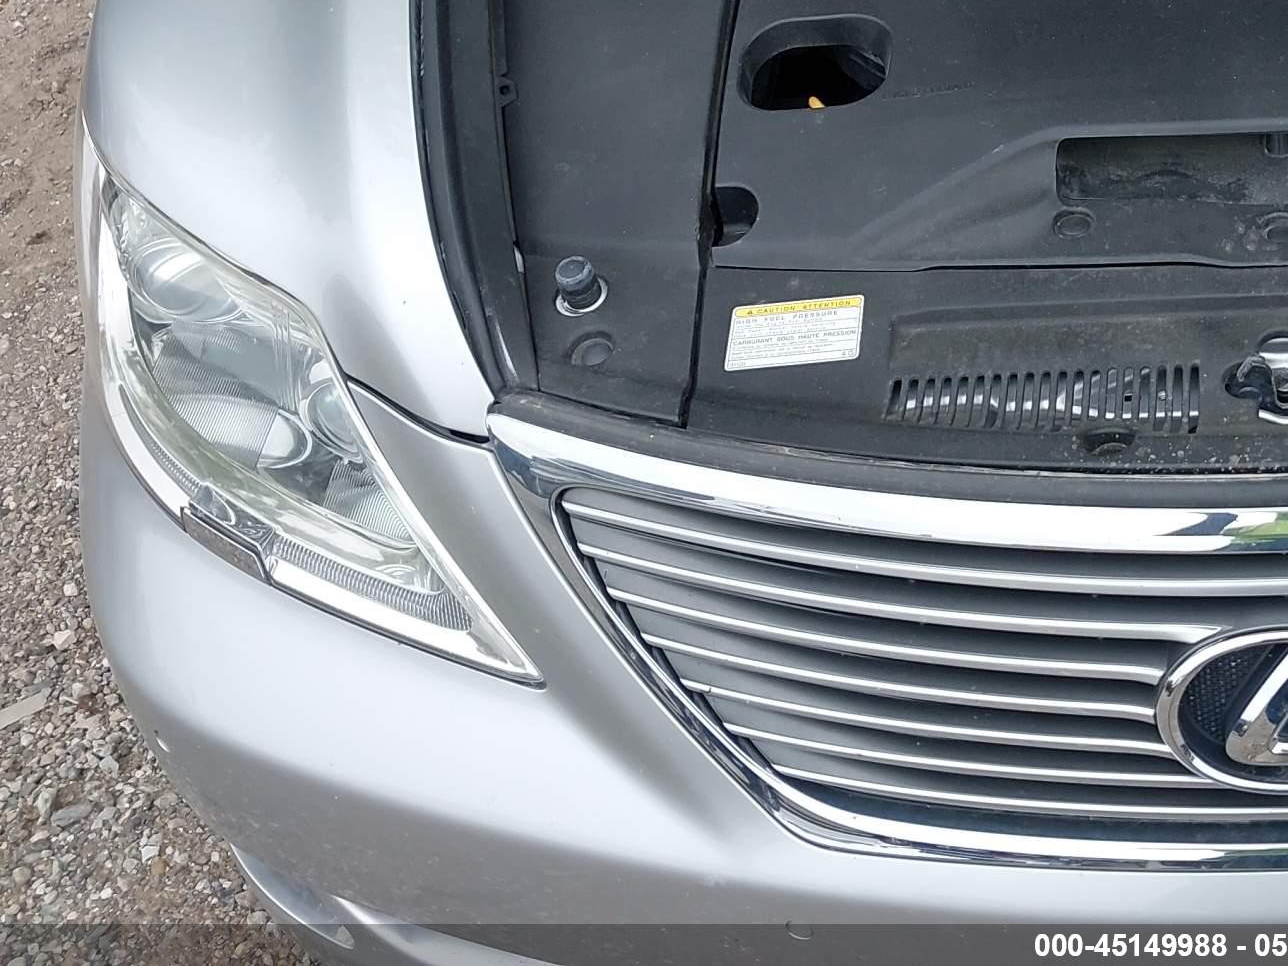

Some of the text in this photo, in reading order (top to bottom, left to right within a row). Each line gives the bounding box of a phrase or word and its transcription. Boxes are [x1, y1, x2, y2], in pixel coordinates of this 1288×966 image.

[757, 301, 851, 314] CAUTION ATTENTION
[792, 311, 838, 319] PRESSURE
